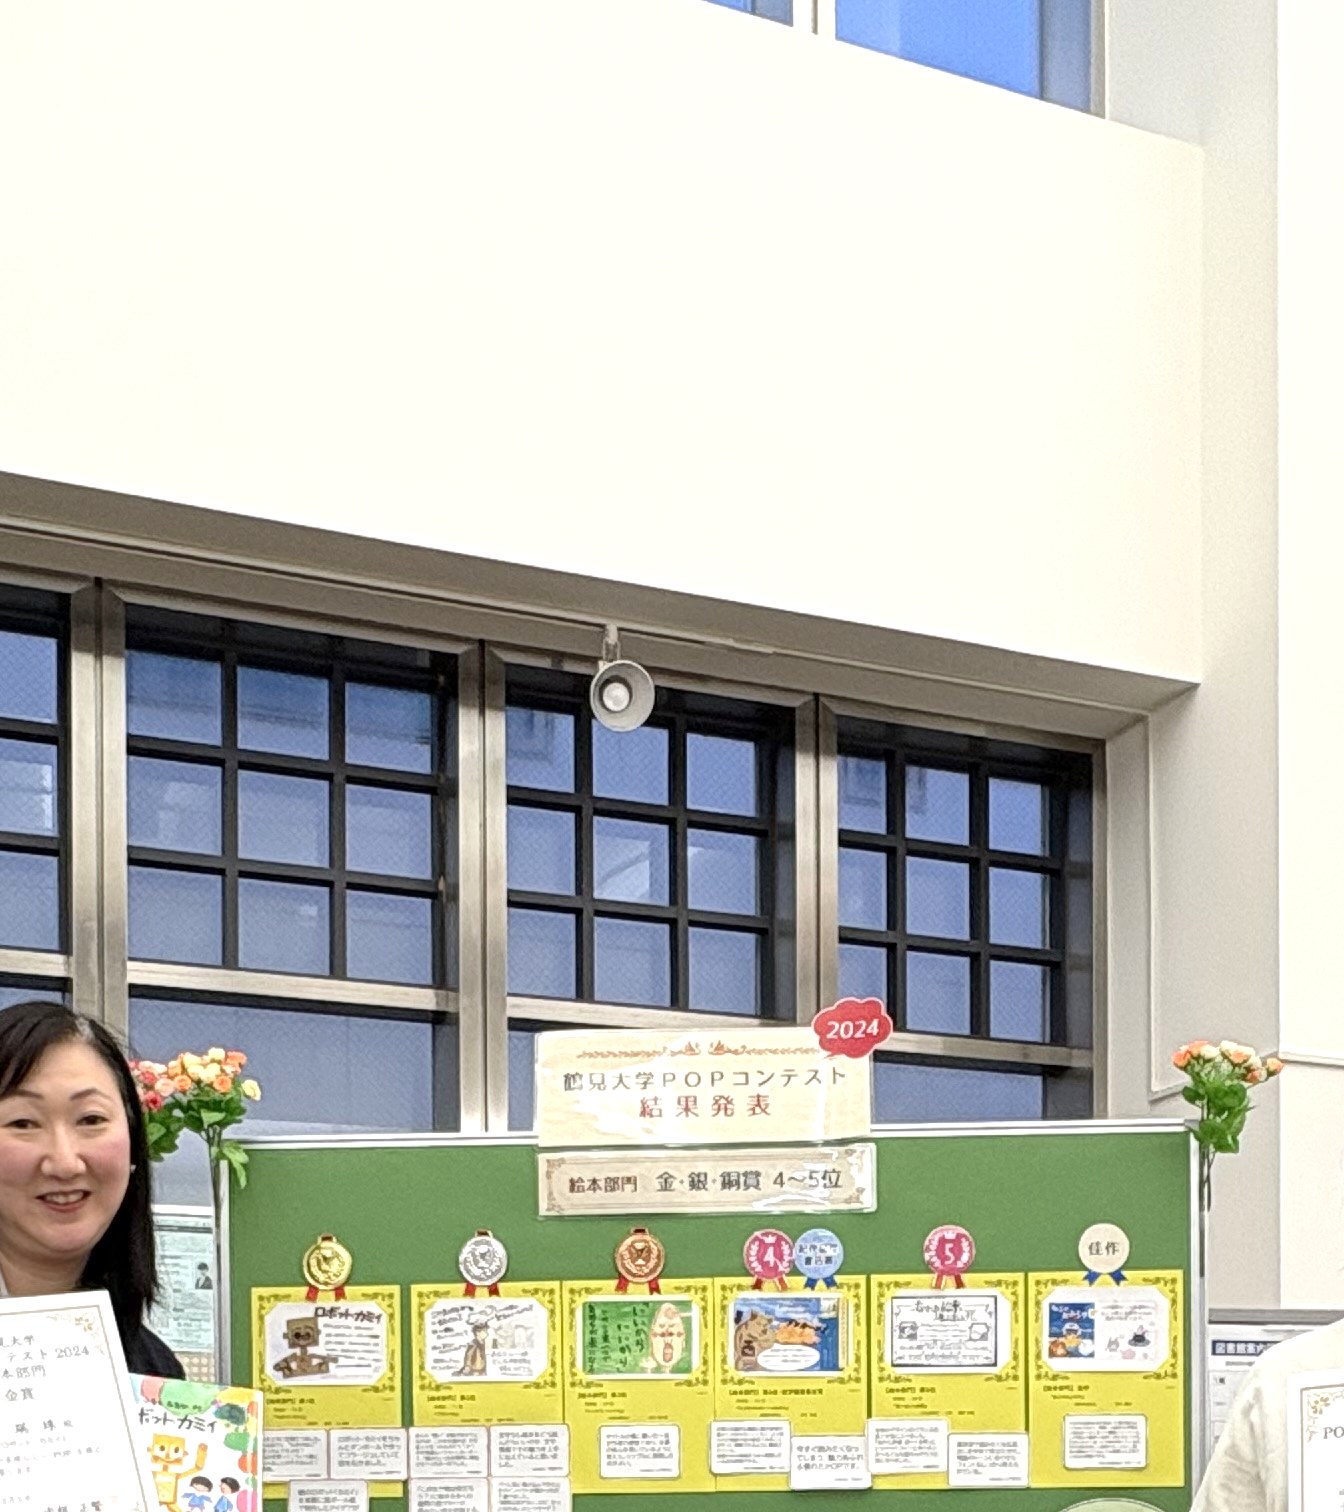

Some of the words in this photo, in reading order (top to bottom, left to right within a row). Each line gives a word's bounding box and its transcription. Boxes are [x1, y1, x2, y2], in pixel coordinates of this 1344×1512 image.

[825, 1018, 880, 1041] 2024
[563, 1066, 846, 1093] 鶴見大学POPコンテスト
[639, 1094, 771, 1118] 結果発表
[568, 1175, 638, 1194] 絵本部門
[763, 1246, 776, 1268] 4
[943, 1242, 955, 1265] 5
[1088, 1240, 1120, 1257] 佳作
[55, 1345, 90, 1360] 2024
